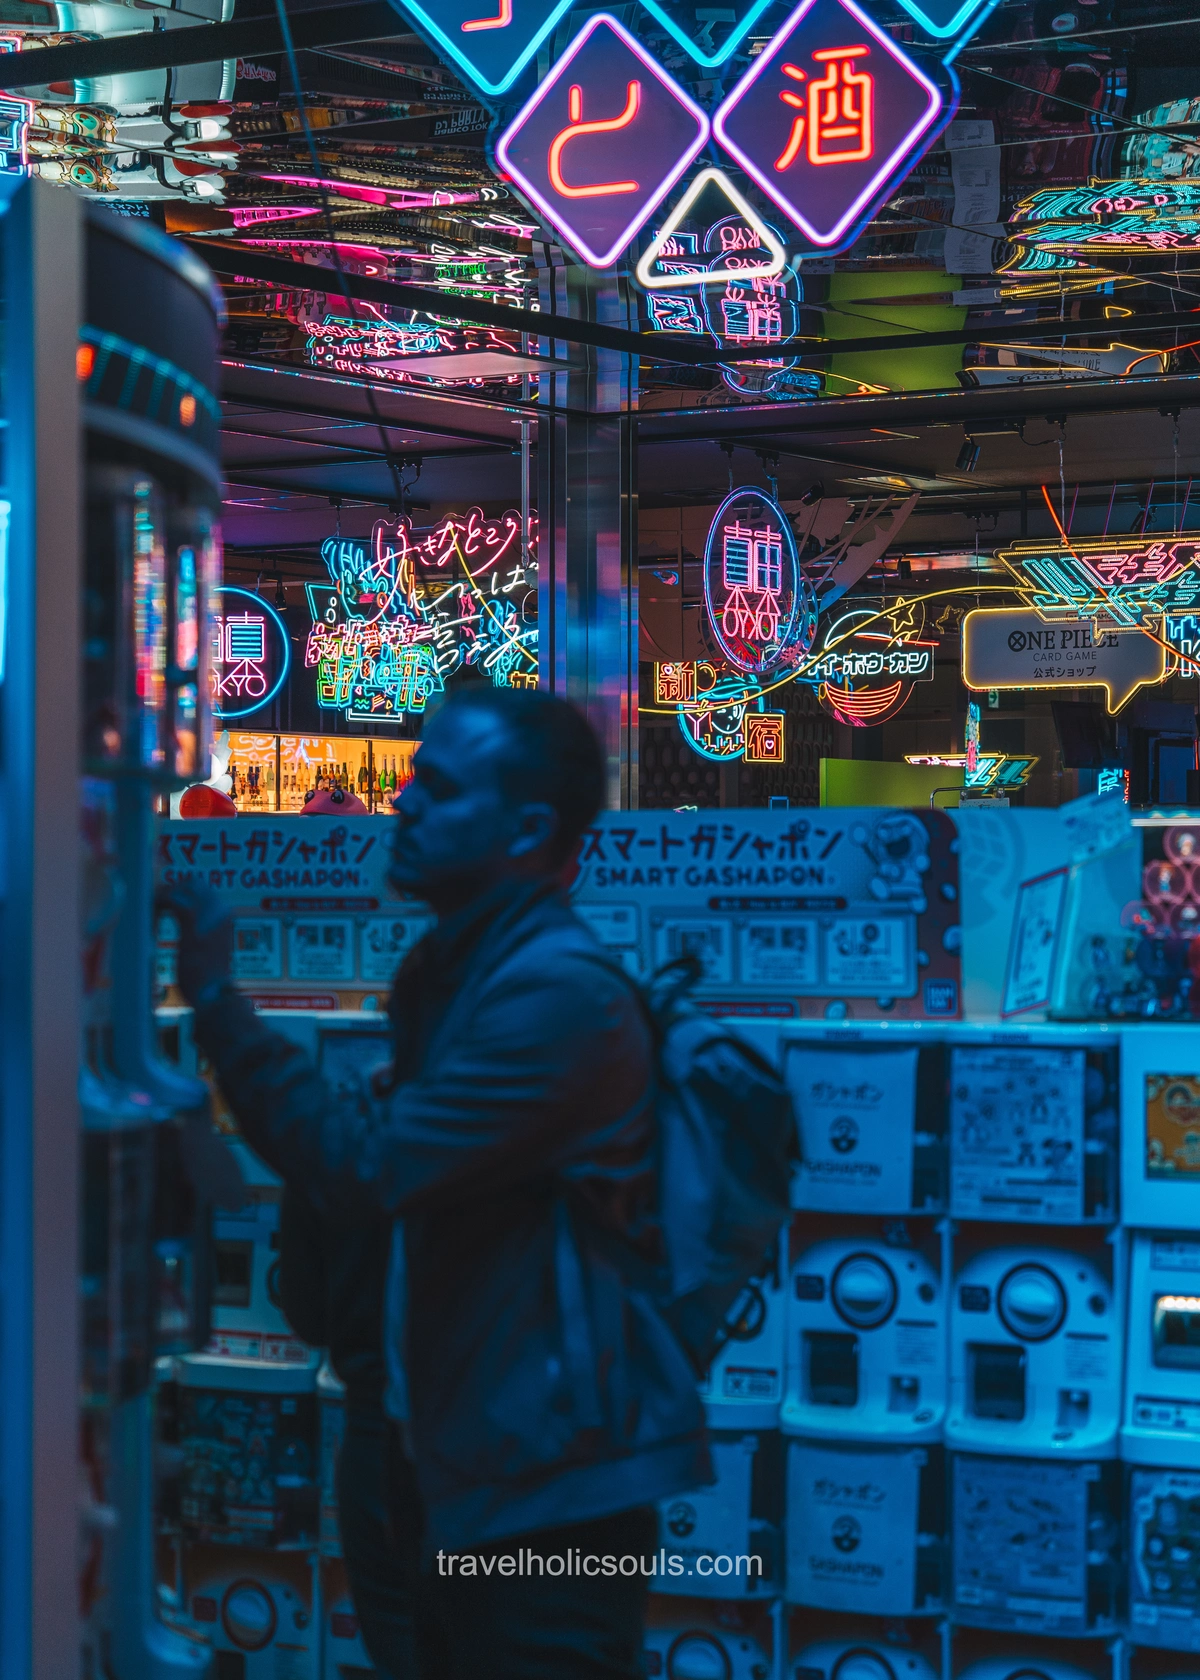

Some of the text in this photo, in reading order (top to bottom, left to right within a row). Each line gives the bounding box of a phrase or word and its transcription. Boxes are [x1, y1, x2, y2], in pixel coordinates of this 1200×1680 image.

[775, 44, 873, 172] 酒
[548, 79, 642, 199] と
[212, 611, 264, 677] 京
[1008, 630, 1055, 652] ONE
[1033, 651, 1097, 662] CARD GAME
[659, 662, 694, 700] 新
[1033, 665, 1097, 679] 公式ショップ
[212, 676, 266, 697] KYO
[584, 820, 843, 862] スマートガシャポン
[164, 868, 361, 889] SMRT GASHAPON
[594, 866, 824, 888] SMART GASHAPON
